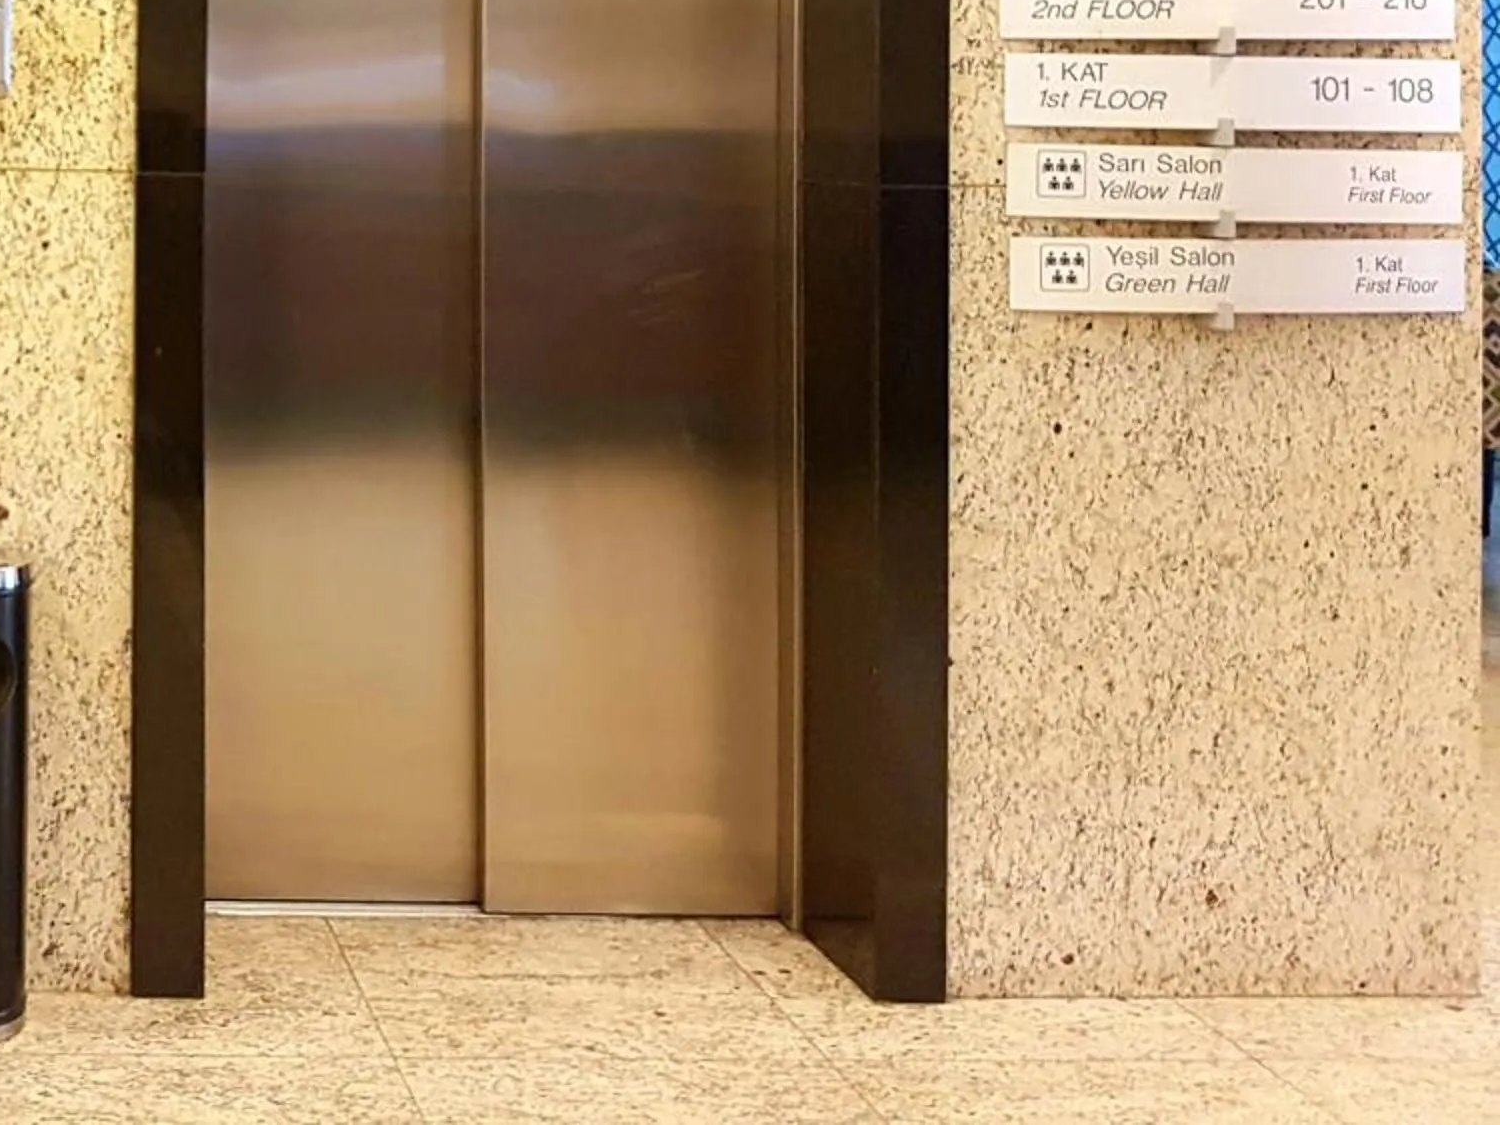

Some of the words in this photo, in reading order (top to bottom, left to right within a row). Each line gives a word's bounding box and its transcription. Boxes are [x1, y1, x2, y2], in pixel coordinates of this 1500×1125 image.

[1032, 0, 1078, 19] 2nd
[1087, 0, 1175, 20] FLOOR
[1038, 62, 1049, 80] 1.
[1062, 62, 1108, 82] KAT
[1041, 89, 1069, 108] 1st
[1079, 89, 1167, 111] FLOOR
[1312, 77, 1349, 102] 101
[1388, 78, 1433, 103] 108
[1157, 154, 1222, 174] Salon
[1350, 166, 1362, 182] 1.
[1369, 166, 1396, 182] Kat
[1100, 180, 1169, 200] Yellow
[1179, 181, 1223, 201] Hall
[1348, 187, 1384, 203] First
[1389, 187, 1431, 204] Floor
[1106, 246, 1159, 269] Yeşil
[1170, 247, 1234, 267] Salon
[1357, 257, 1369, 272] 1.
[1376, 256, 1402, 272] Kat
[1106, 273, 1176, 293] Green
[1186, 274, 1230, 293] Hall
[1355, 277, 1391, 294] First
[1396, 277, 1438, 293] Floor
